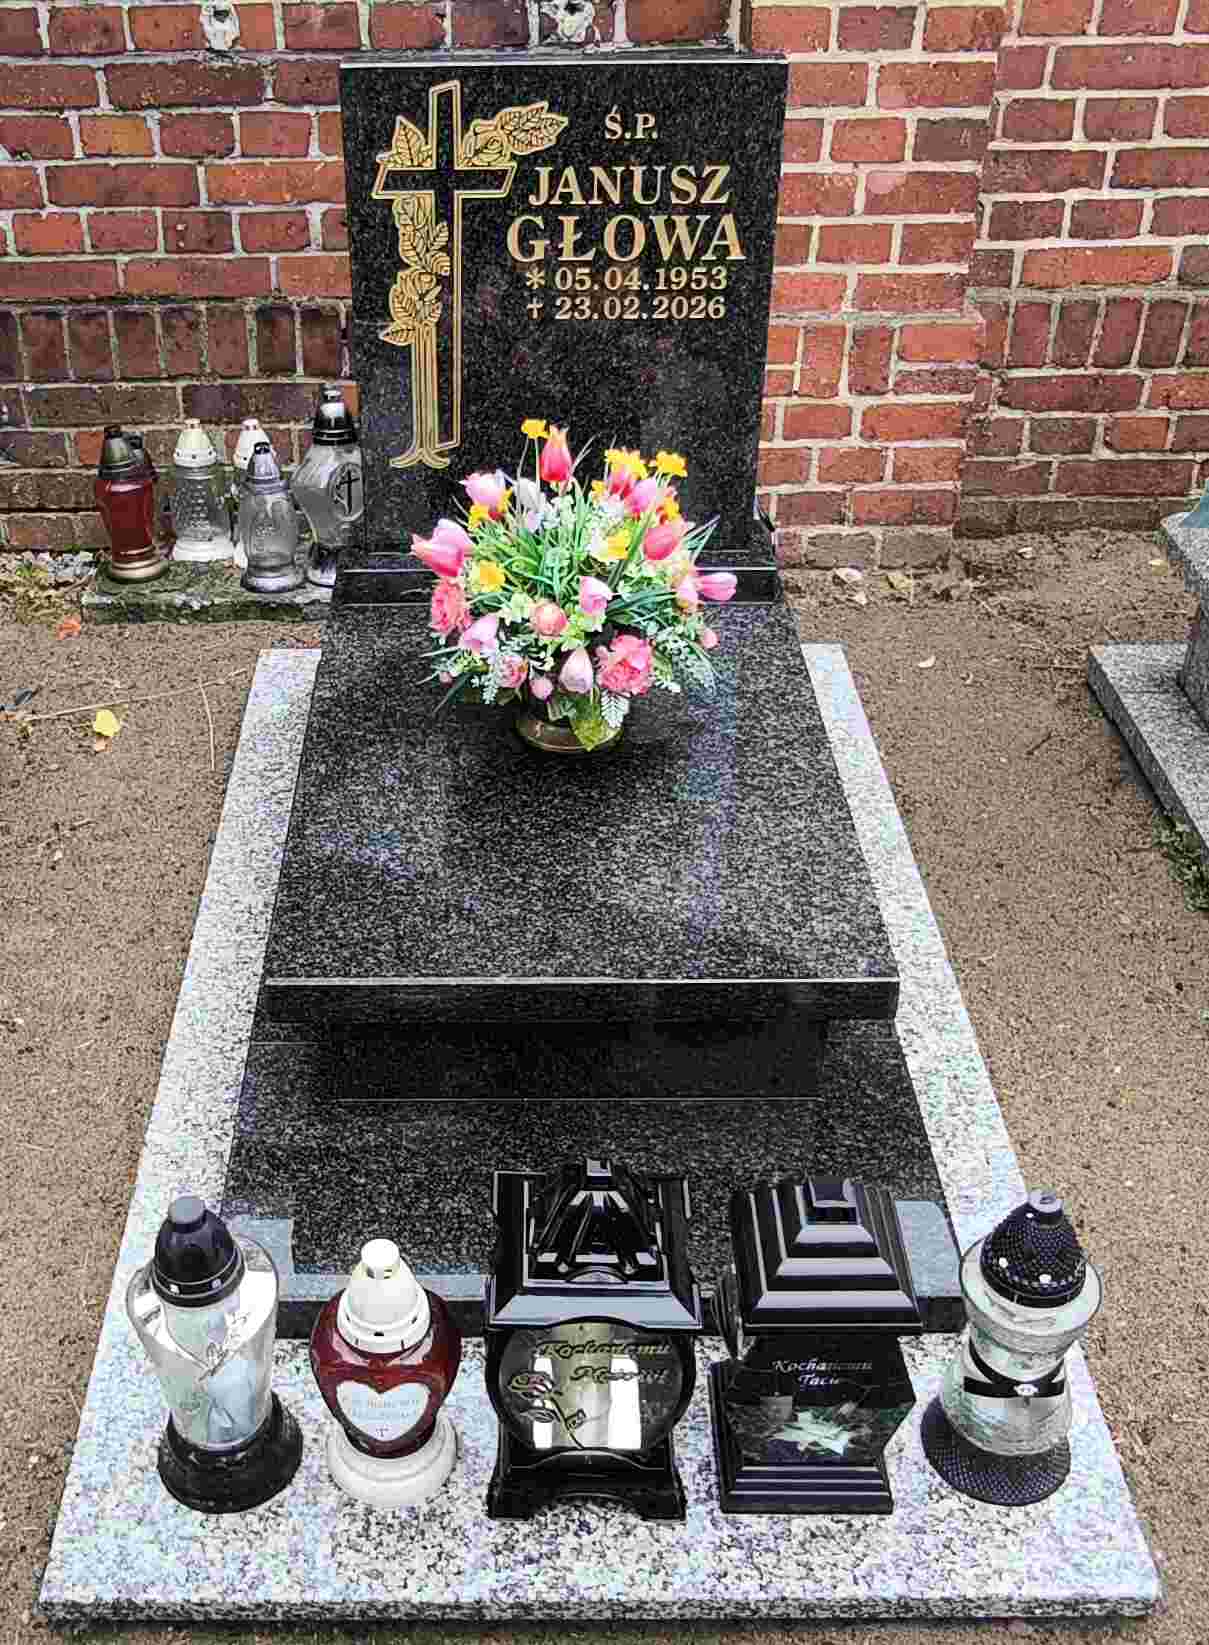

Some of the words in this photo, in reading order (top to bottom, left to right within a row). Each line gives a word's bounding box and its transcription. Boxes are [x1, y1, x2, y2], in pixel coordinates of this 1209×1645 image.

[604, 104, 658, 140] Ś.P.
[528, 164, 731, 206] JANUSZ
[506, 213, 747, 262] GŁOWA
[554, 267, 728, 291] 05.04.1953
[554, 296, 726, 320] 23.02.2026
